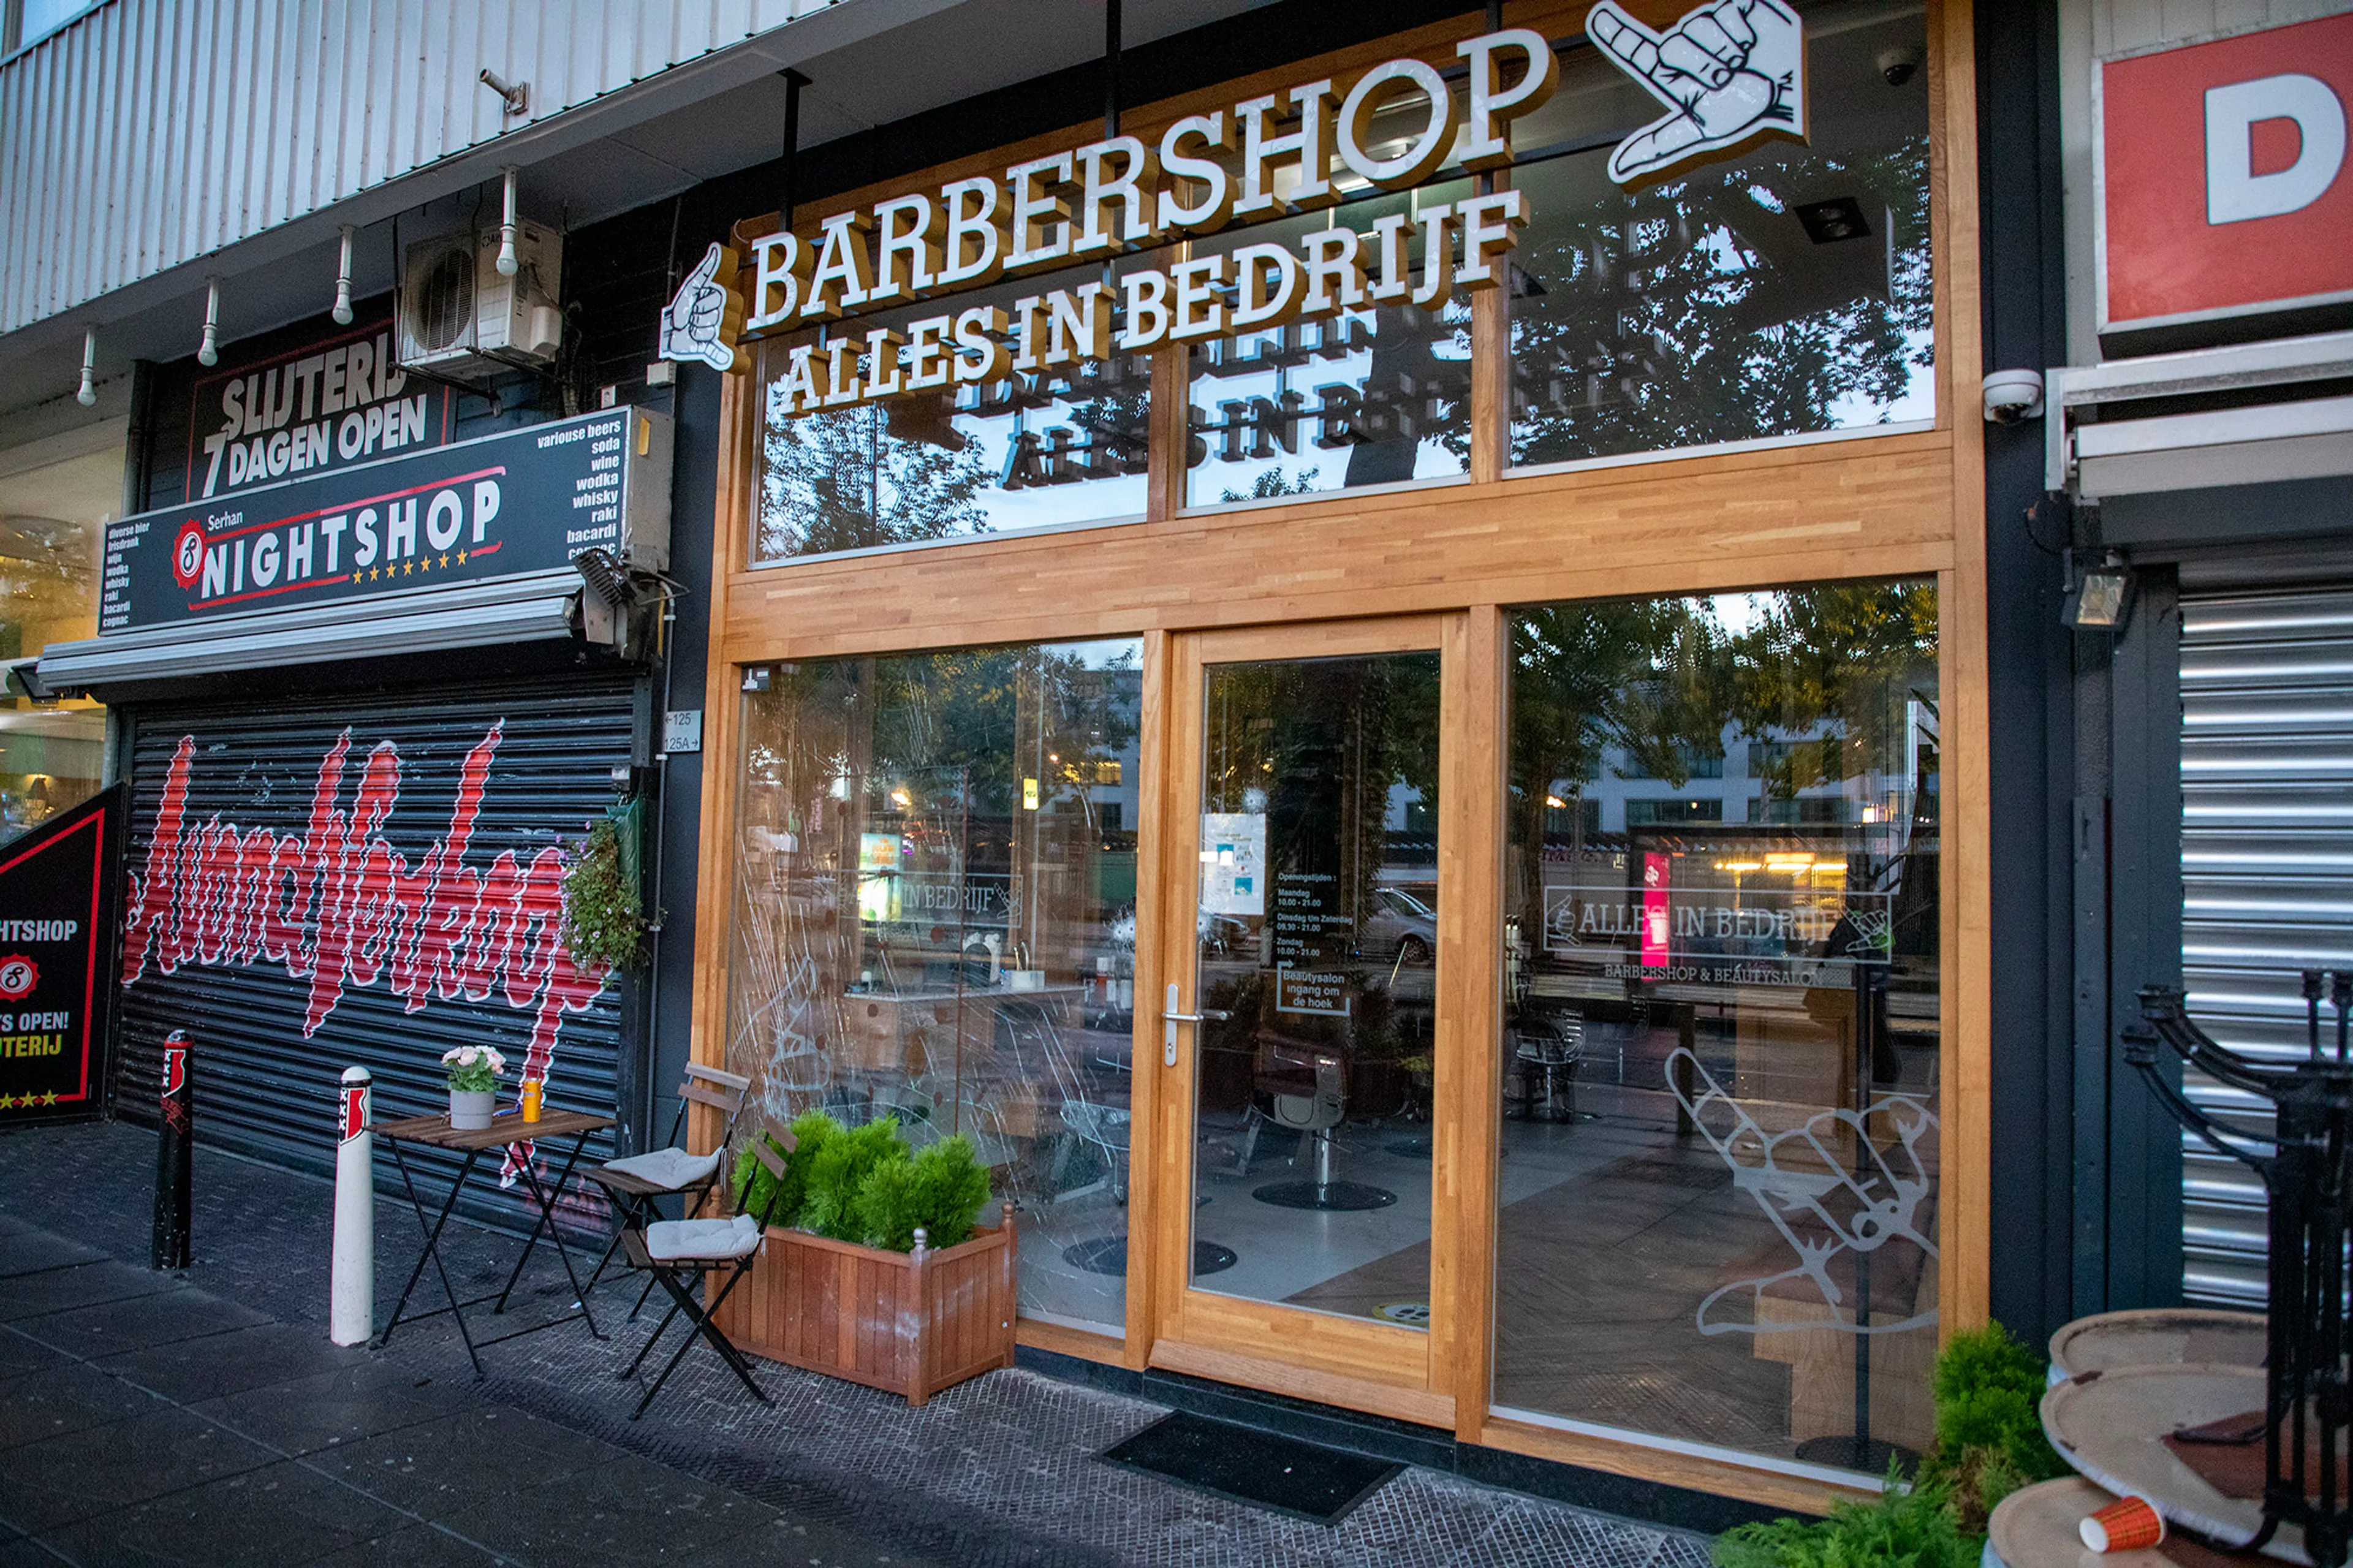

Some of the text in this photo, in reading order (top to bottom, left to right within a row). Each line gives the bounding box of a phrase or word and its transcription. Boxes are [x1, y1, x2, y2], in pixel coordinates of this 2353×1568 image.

[2205, 72, 2347, 226] D
[746, 28, 1550, 331] BARBERSHOP
[779, 189, 1521, 415] ALLES IN BEDRIJF
[537, 420, 621, 449] variouse beers
[202, 393, 428, 498] 7 DAGEN OPEN
[591, 437, 620, 454] soda
[591, 455, 620, 471] wine
[576, 472, 619, 491] wodka
[573, 490, 619, 509] whisky
[208, 509, 243, 532] Serhan
[591, 506, 618, 523] raki
[109, 522, 150, 539] diverse bier
[567, 523, 617, 543] bacardi
[108, 537, 140, 552] frisdrank
[201, 479, 501, 599] NIGHTSHOP
[107, 553, 123, 565] wijn
[106, 565, 129, 577] wodka
[105, 577, 130, 590] whisky
[104, 590, 119, 602] raki
[104, 600, 131, 615] bacardi
[103, 615, 129, 627] cognac
[673, 713, 692, 725] 125
[665, 737, 690, 750] 125A
[924, 885, 995, 914] BEDRIJF
[1278, 888, 1310, 898] Maandag
[1276, 922, 1296, 931] 09.30
[1302, 923, 1321, 932] 21.00
[1277, 913, 1306, 923] Dinsdag
[1320, 914, 1353, 926] Zaterdag
[1578, 903, 1839, 946] ALLES IN BEDRIJF
[1276, 937, 1303, 948] Zondag
[1277, 947, 1295, 955] 10.00
[1301, 948, 1320, 956] 21.00
[1283, 970, 1345, 985] Beautysalon
[1604, 964, 1697, 981] BARBERSHOP
[1700, 968, 1711, 982] &
[1287, 984, 1340, 998] ingang om
[1293, 997, 1333, 1009] de hoek
[19, 1011, 69, 1031] OPEN!
